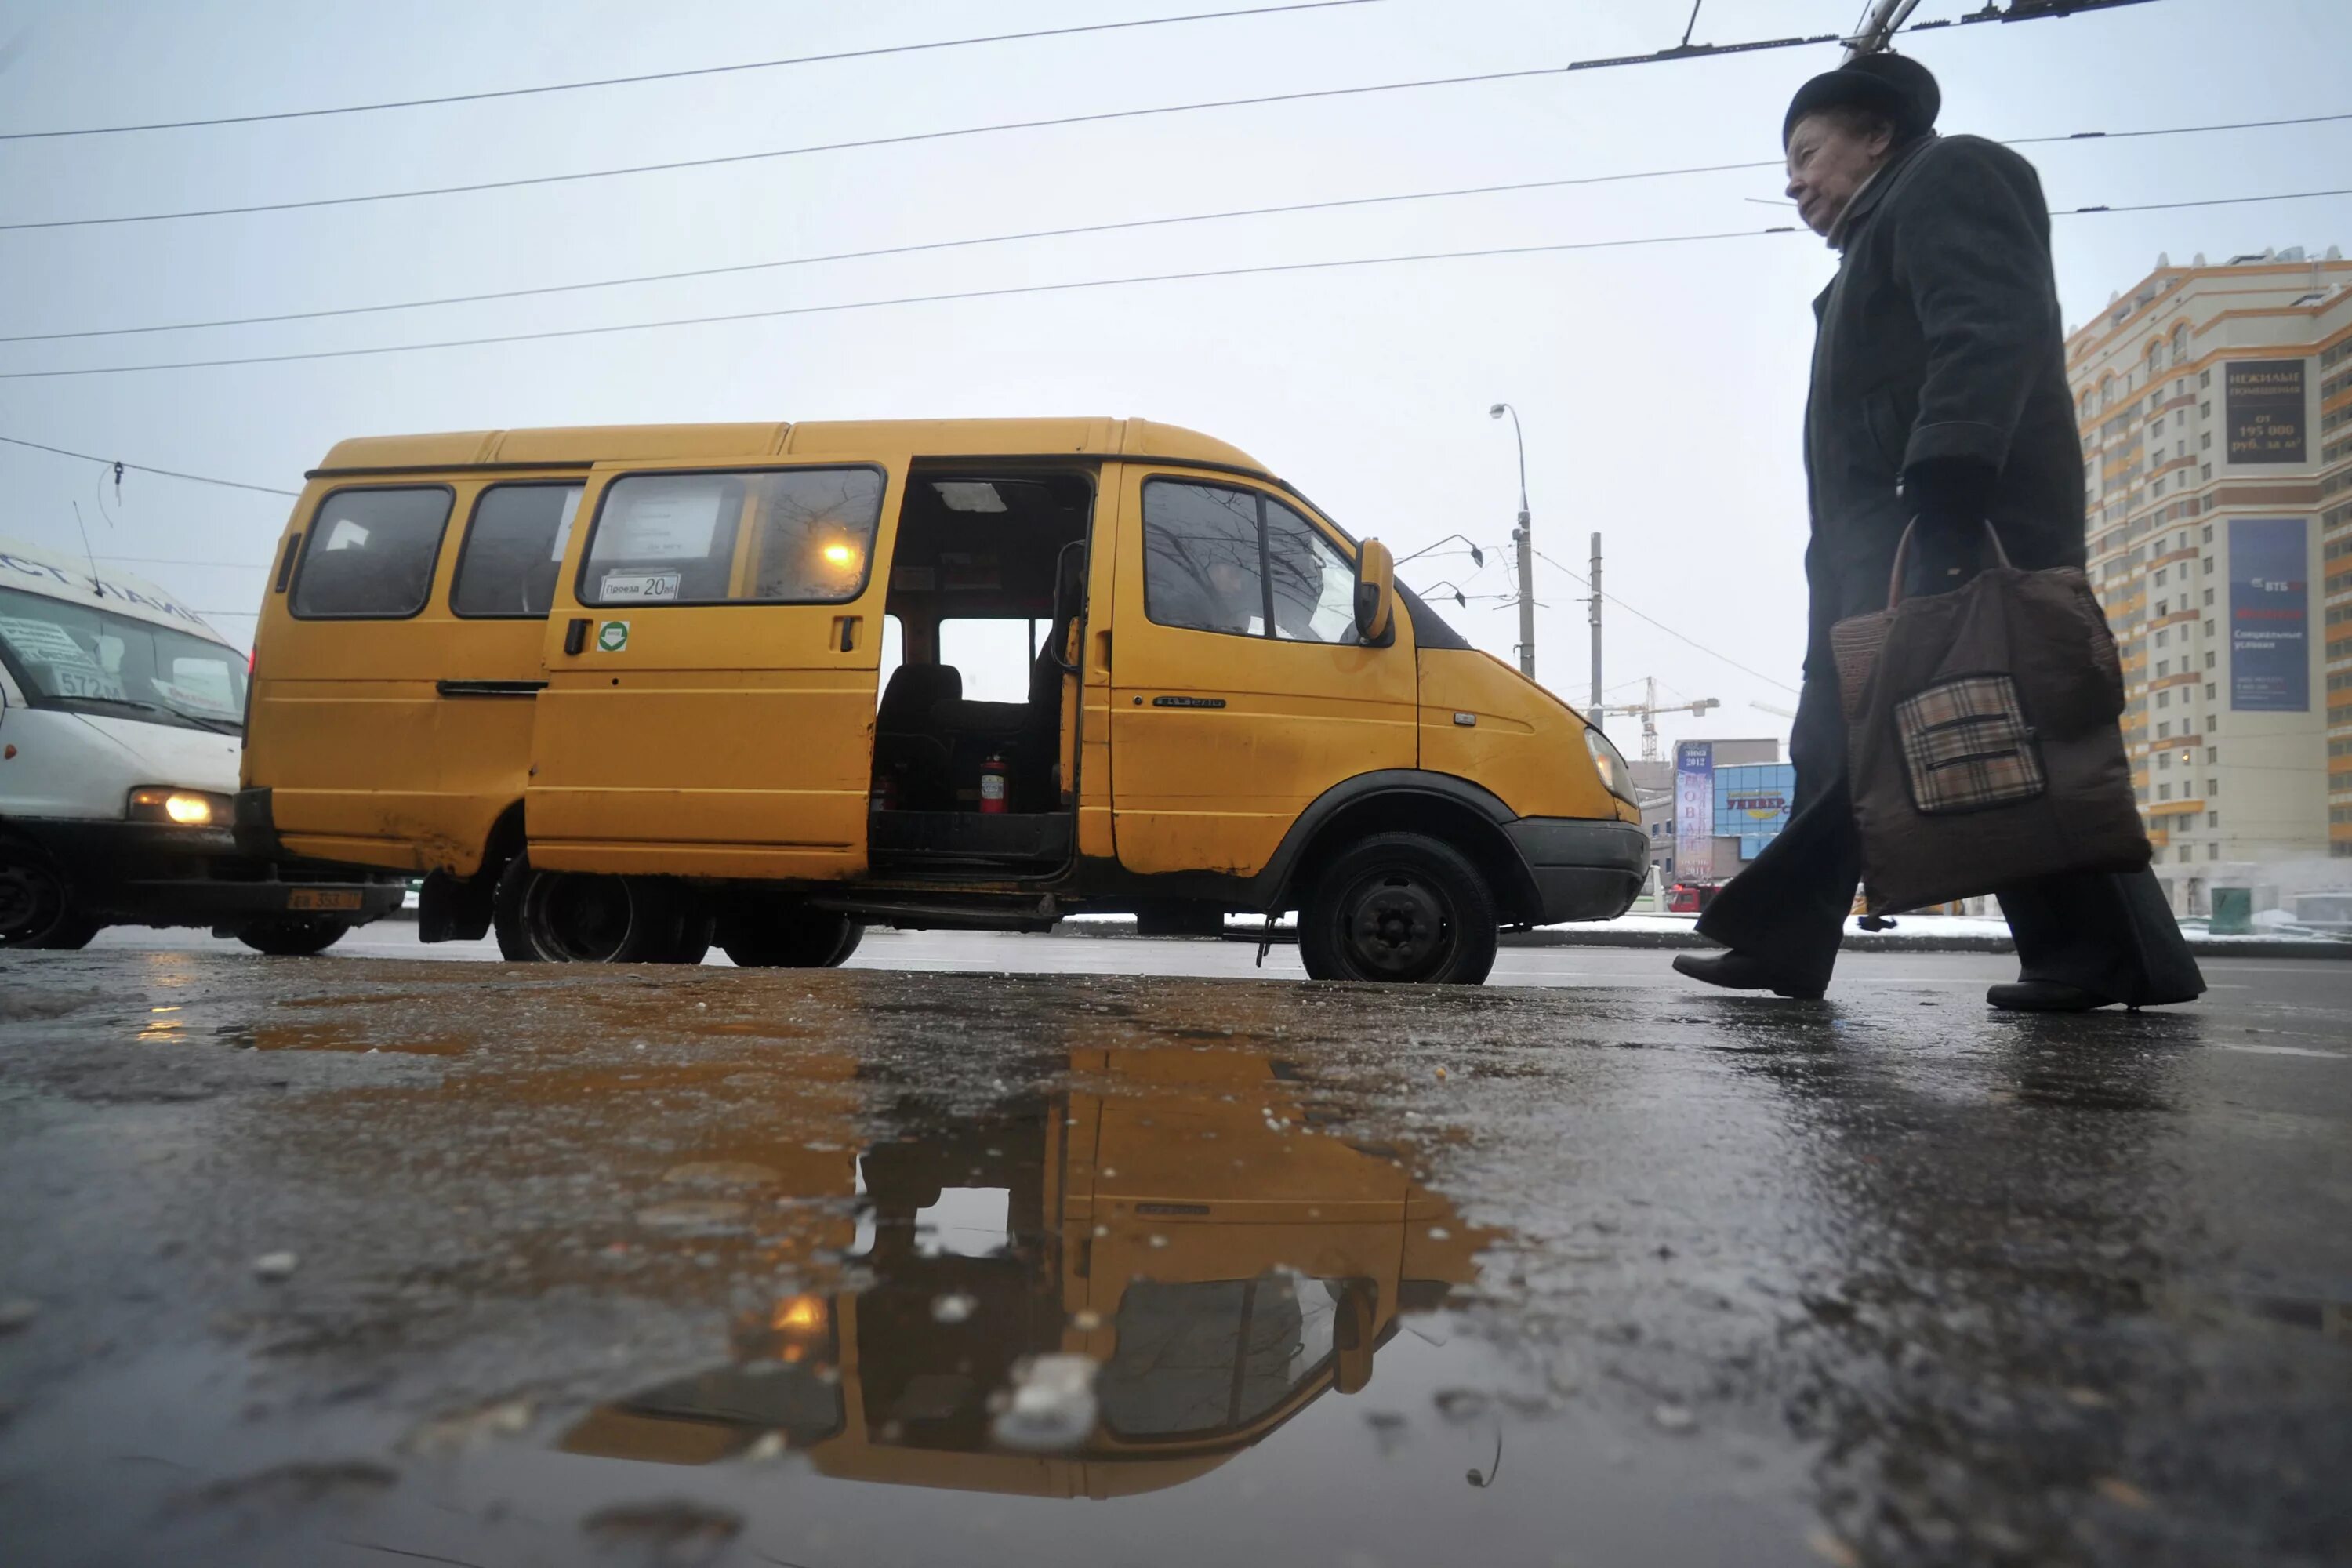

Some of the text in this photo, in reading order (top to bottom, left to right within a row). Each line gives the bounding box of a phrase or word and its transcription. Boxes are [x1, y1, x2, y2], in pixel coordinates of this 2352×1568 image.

[2239, 425, 2295, 437] 195 000
[644, 578, 666, 596] 20
[1686, 757, 1706, 767] 2012
